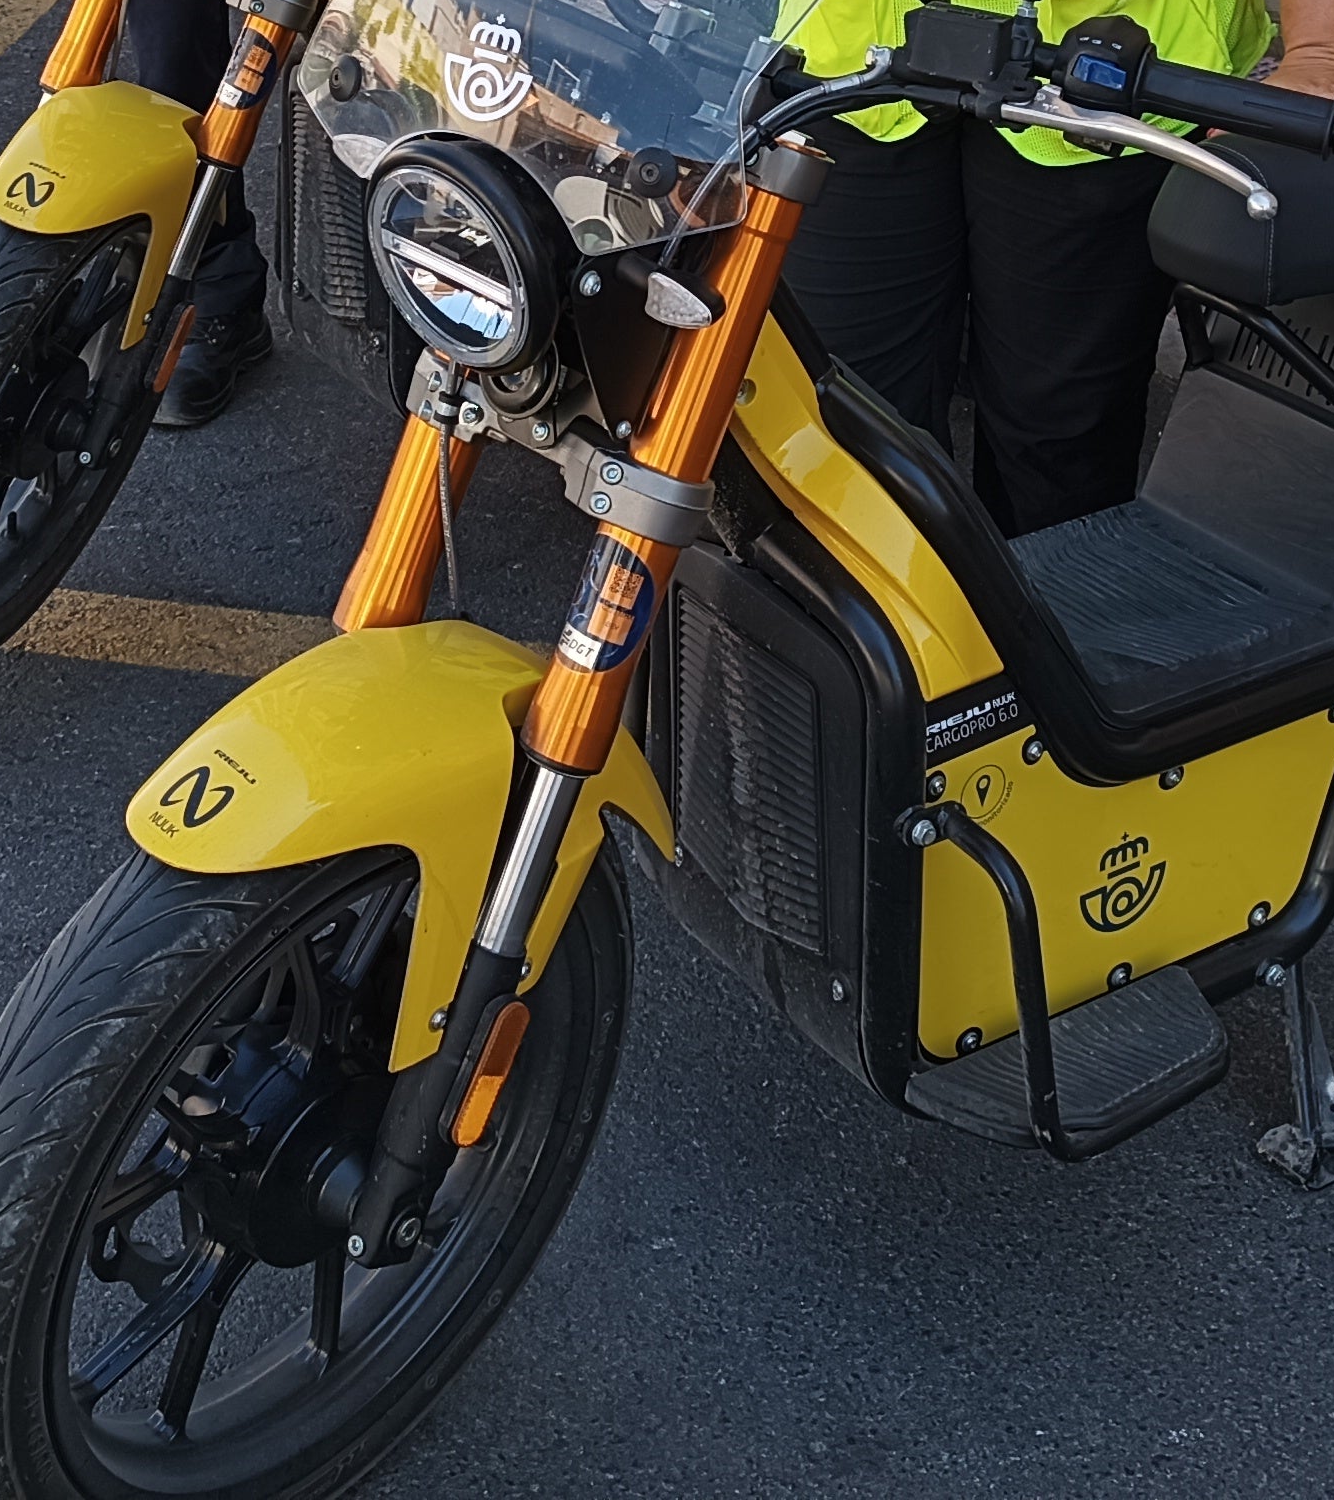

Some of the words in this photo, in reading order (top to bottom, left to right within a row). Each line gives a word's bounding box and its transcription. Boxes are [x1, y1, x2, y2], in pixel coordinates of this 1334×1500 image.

[568, 638, 595, 658] DGT
[925, 712, 996, 754] CARGOPRO
[998, 703, 1019, 722] 6.0
[926, 701, 991, 737] RIEJU
[992, 691, 1016, 709] NUUK
[213, 748, 257, 785] RIEJU
[148, 810, 180, 838] NUUK
